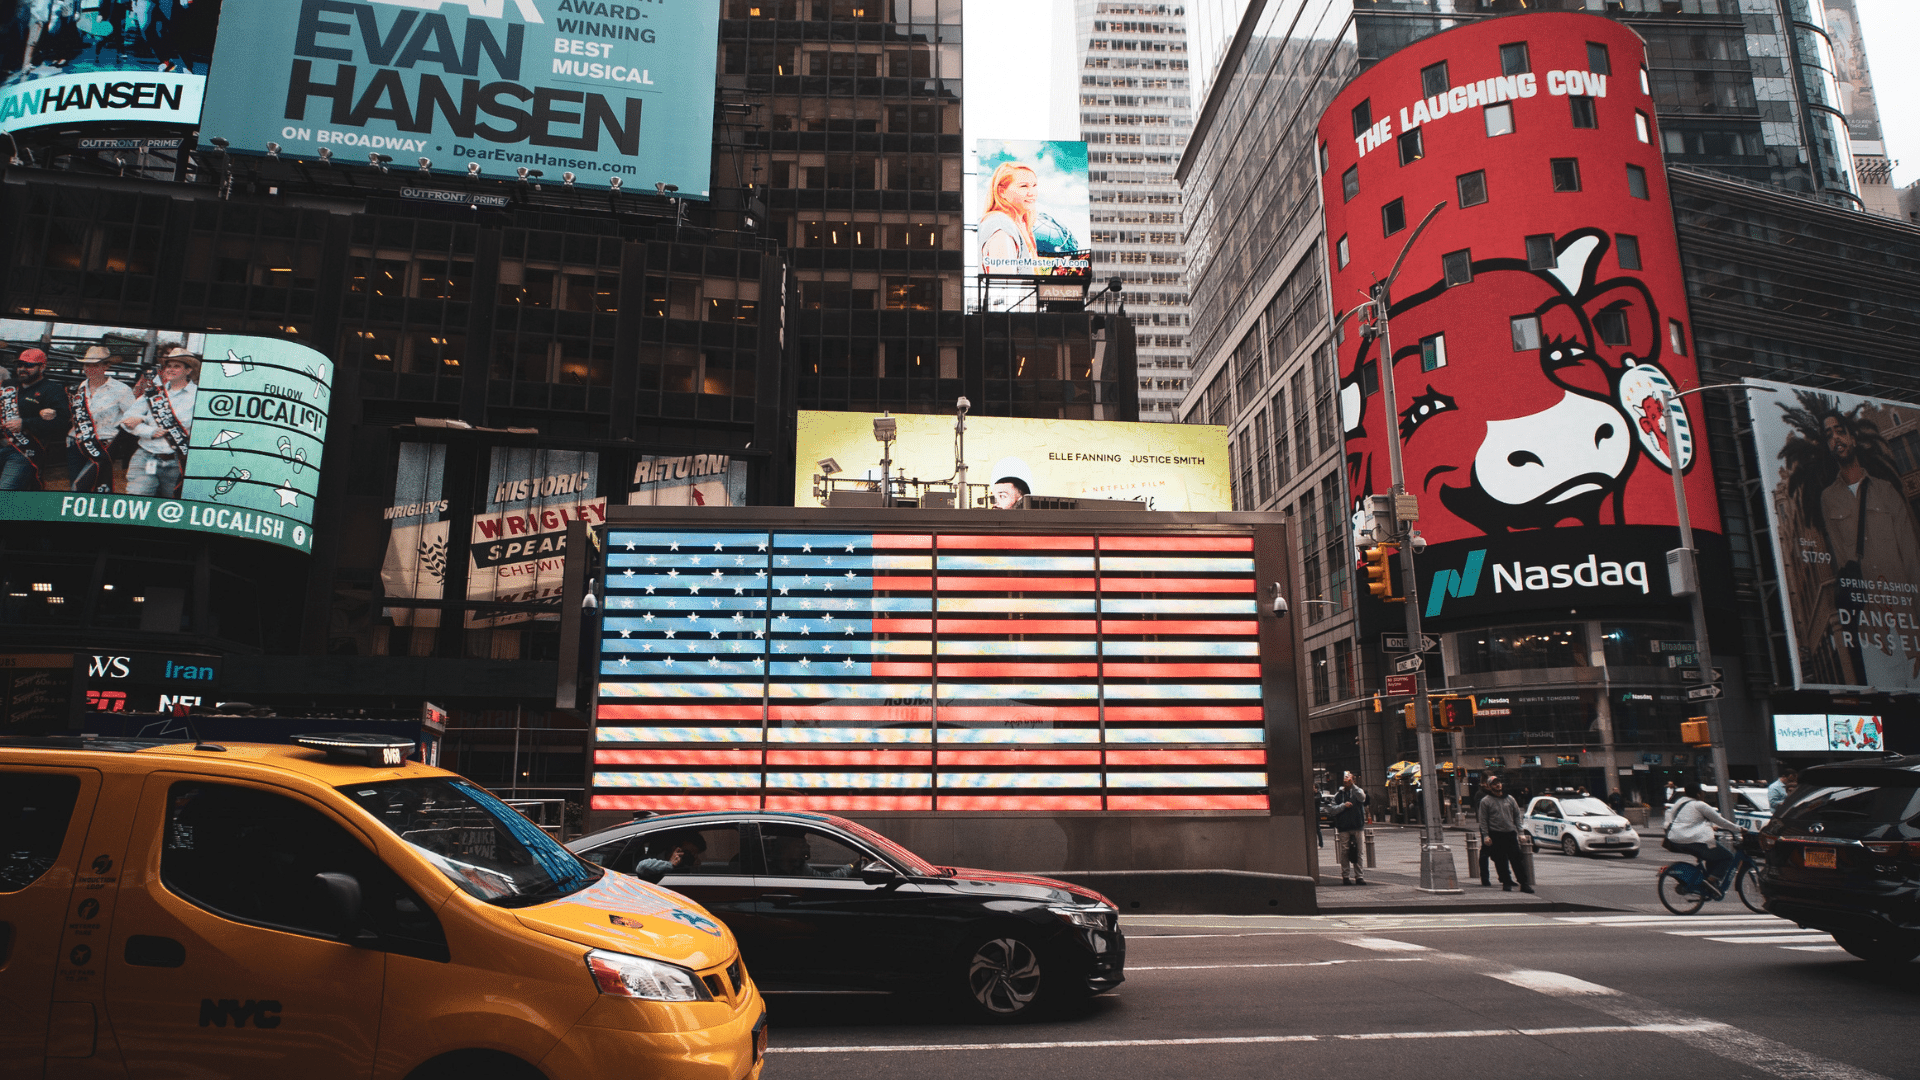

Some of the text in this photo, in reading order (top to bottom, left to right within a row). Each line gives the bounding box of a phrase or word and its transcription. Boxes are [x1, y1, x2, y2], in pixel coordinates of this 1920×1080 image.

[558, 0, 648, 22] AWARD-
[294, 0, 525, 81] EVAN
[556, 18, 656, 43] WINNING
[554, 38, 613, 59] BEST
[552, 59, 654, 85] MUSICAL
[40, 82, 184, 114] HANSEN
[284, 59, 643, 156] HANSEN
[1355, 69, 1607, 158] THE LAUGHING COW
[80, 139, 181, 148] OUTFRONT PRIME
[282, 126, 428, 154] ON BROADWAY
[453, 144, 637, 176] DearEvanHansen.com
[402, 188, 506, 206] OUTFRONT PRIME
[985, 257, 1089, 268] SupremeMasterTV.com
[264, 383, 303, 400] FOLLOW
[1049, 452, 1206, 466] ELLE FANNING JUSTICE SMITH
[634, 454, 730, 487] RETURN!
[494, 472, 589, 505] HISTORIC
[1093, 484, 1136, 492] NETFLIX
[61, 496, 285, 540] FOLLOW @ LOCALISH
[383, 499, 449, 521] WRIGLEY'S
[1492, 554, 1650, 595] Nasdaq
[1840, 578, 1919, 593] SPRING FASHION
[1851, 592, 1913, 606] SELECTED BY
[1390, 639, 1408, 647] ONE
[165, 660, 213, 681] Iran
[1544, 823, 1559, 837] NYPD
[200, 1000, 282, 1029] NYC
